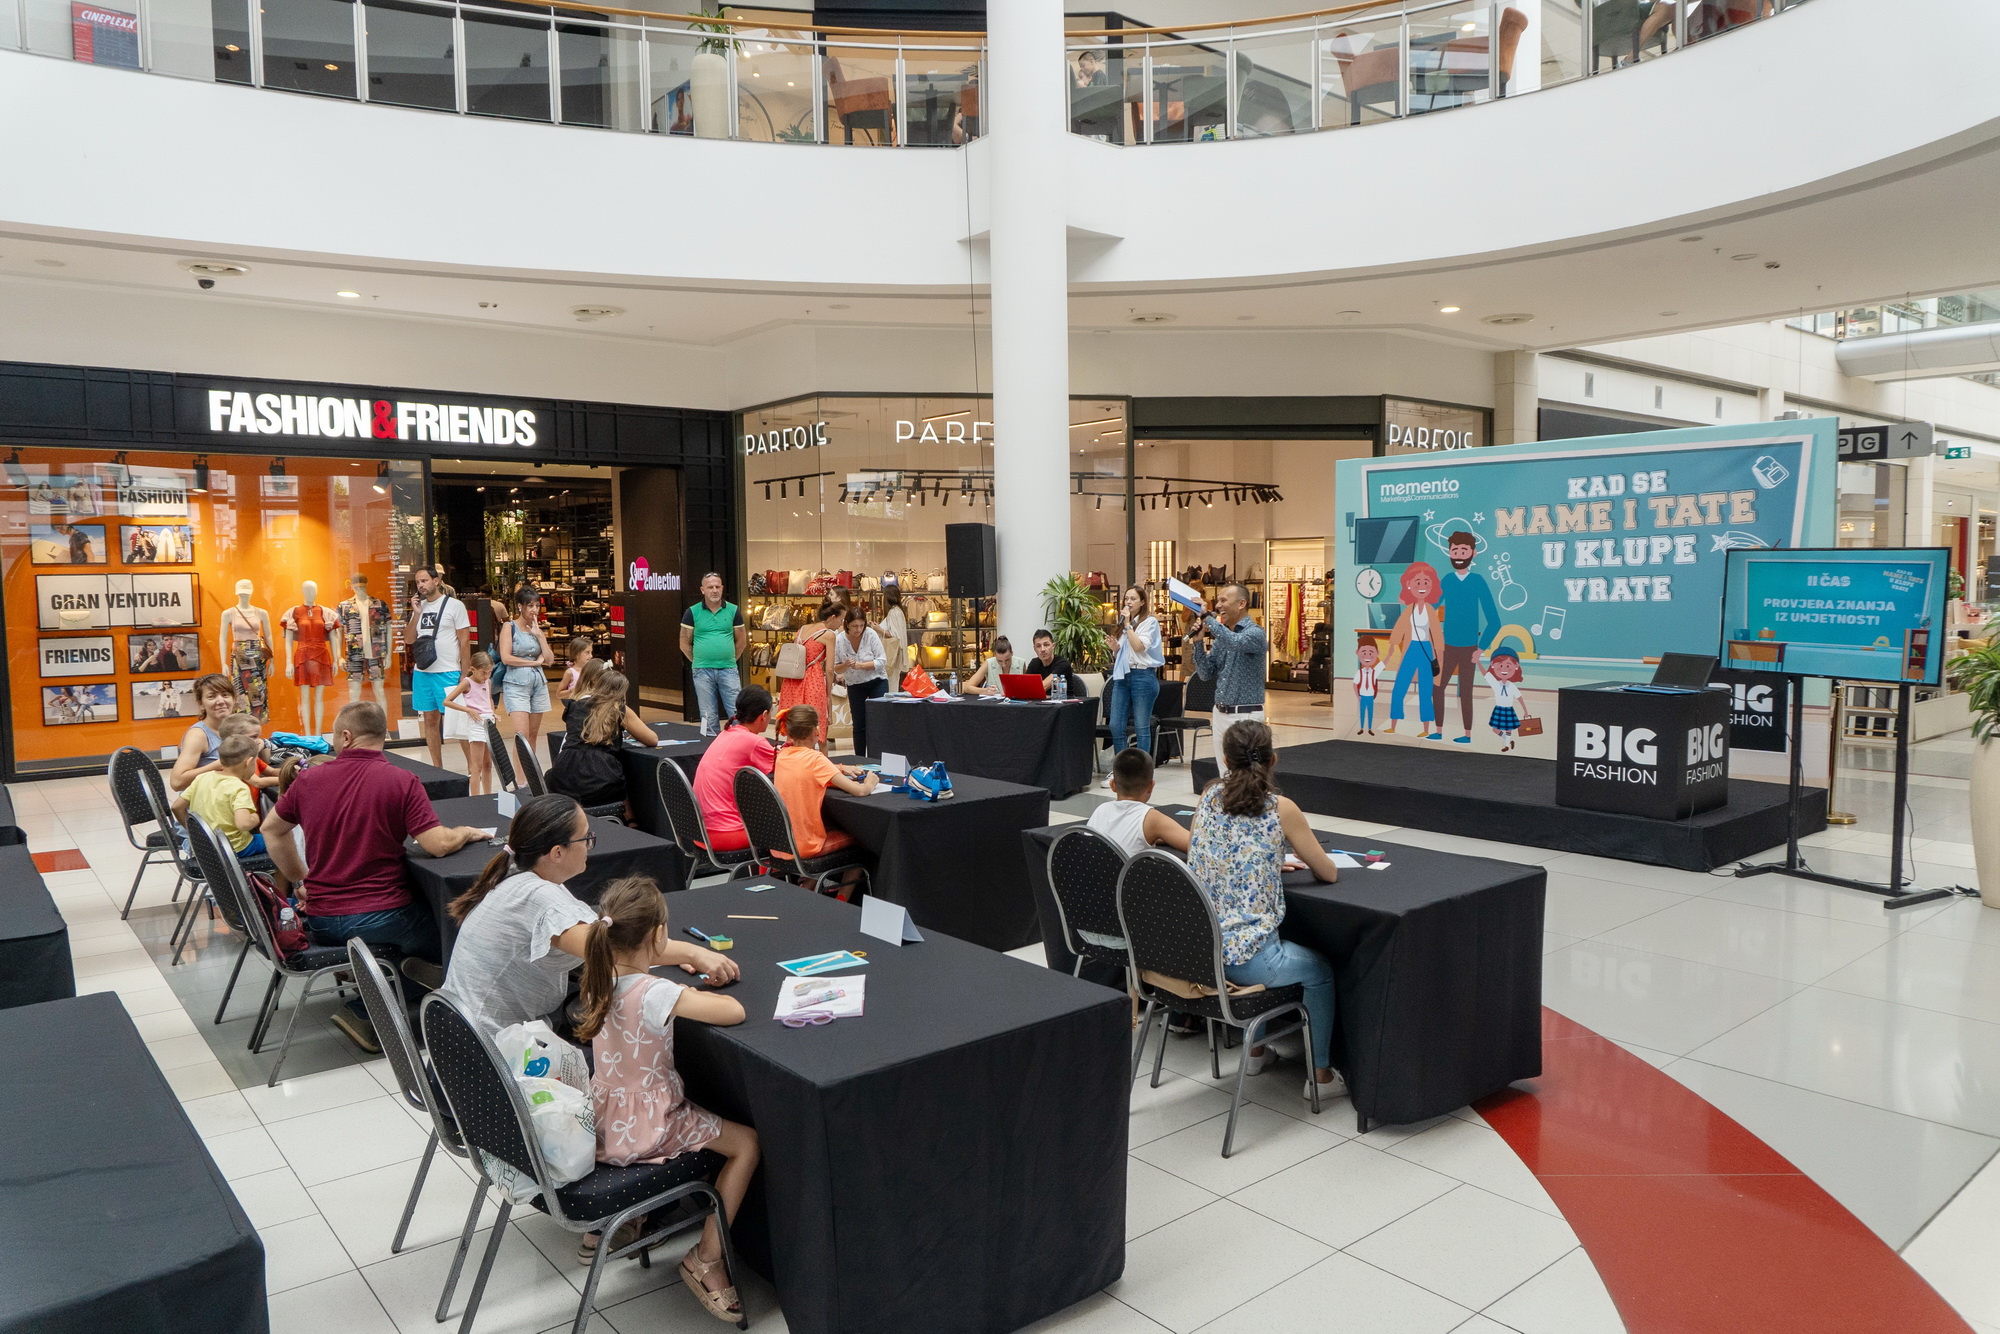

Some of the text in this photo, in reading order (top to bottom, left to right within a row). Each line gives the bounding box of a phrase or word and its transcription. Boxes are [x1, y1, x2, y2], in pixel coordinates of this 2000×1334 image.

[81, 10, 137, 30] CINEPLEXX
[208, 389, 537, 447] FASHION&FRIENDS
[745, 421, 828, 456] PARFOIS
[896, 420, 991, 445] PARF
[1861, 436, 1876, 450] G
[1380, 477, 1460, 496] memento
[1567, 469, 1668, 499] KAD SE
[119, 489, 184, 505] FASHION
[1380, 493, 1460, 503] Marketing&Communications
[1495, 489, 1757, 537] MAME I TATE
[1542, 534, 1697, 569] U KLUPE
[644, 572, 680, 591] collection
[1564, 575, 1672, 602] VRATE
[1820, 573, 1851, 587] ČAS
[51, 592, 181, 611] GRAN VENTURA
[1763, 598, 1896, 611] PROVJERA ZNANJA
[1775, 612, 1880, 625] IZ UMJETNOSTI
[45, 647, 111, 665] FRIENDS
[1729, 713, 1773, 728] SHION
[1574, 722, 1658, 766] BIG
[1687, 722, 1724, 766] BIG
[1573, 762, 1657, 786] FASHION
[1685, 762, 1723, 786] FASHION
